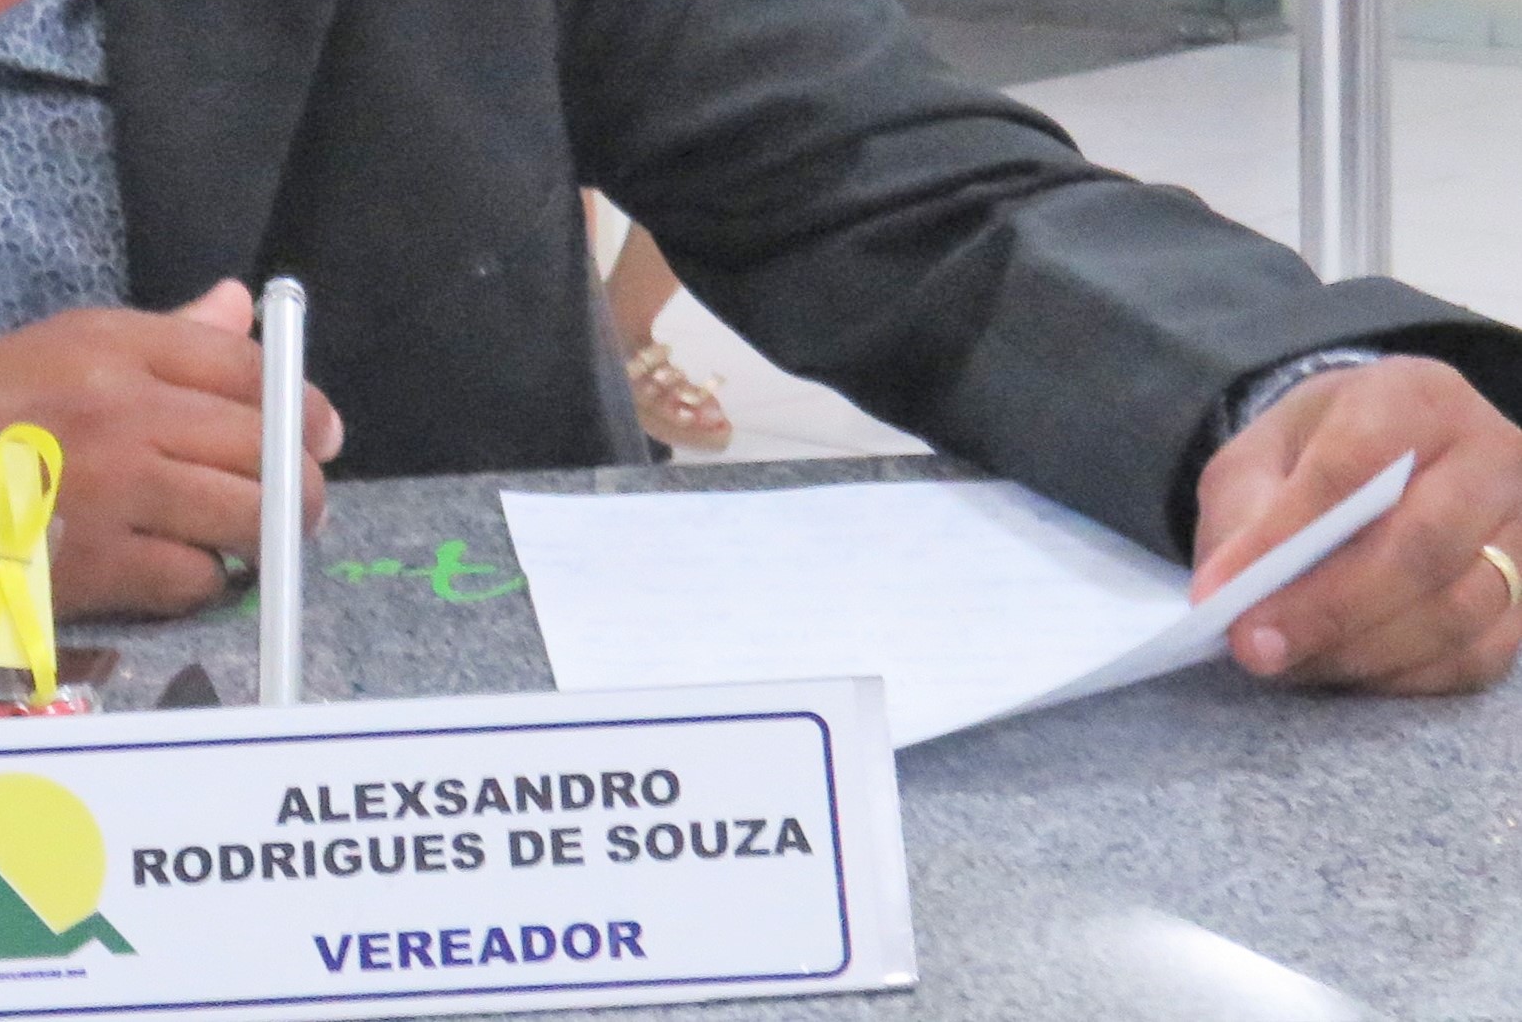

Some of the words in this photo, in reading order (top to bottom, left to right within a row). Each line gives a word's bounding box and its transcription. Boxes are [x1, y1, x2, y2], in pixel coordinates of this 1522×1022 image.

[277, 769, 680, 825] ALEXSANDRO
[132, 831, 485, 886] RODRIGUES
[508, 828, 584, 868] DE
[607, 817, 813, 863] SOUZA
[313, 920, 646, 974] VEREADOR
